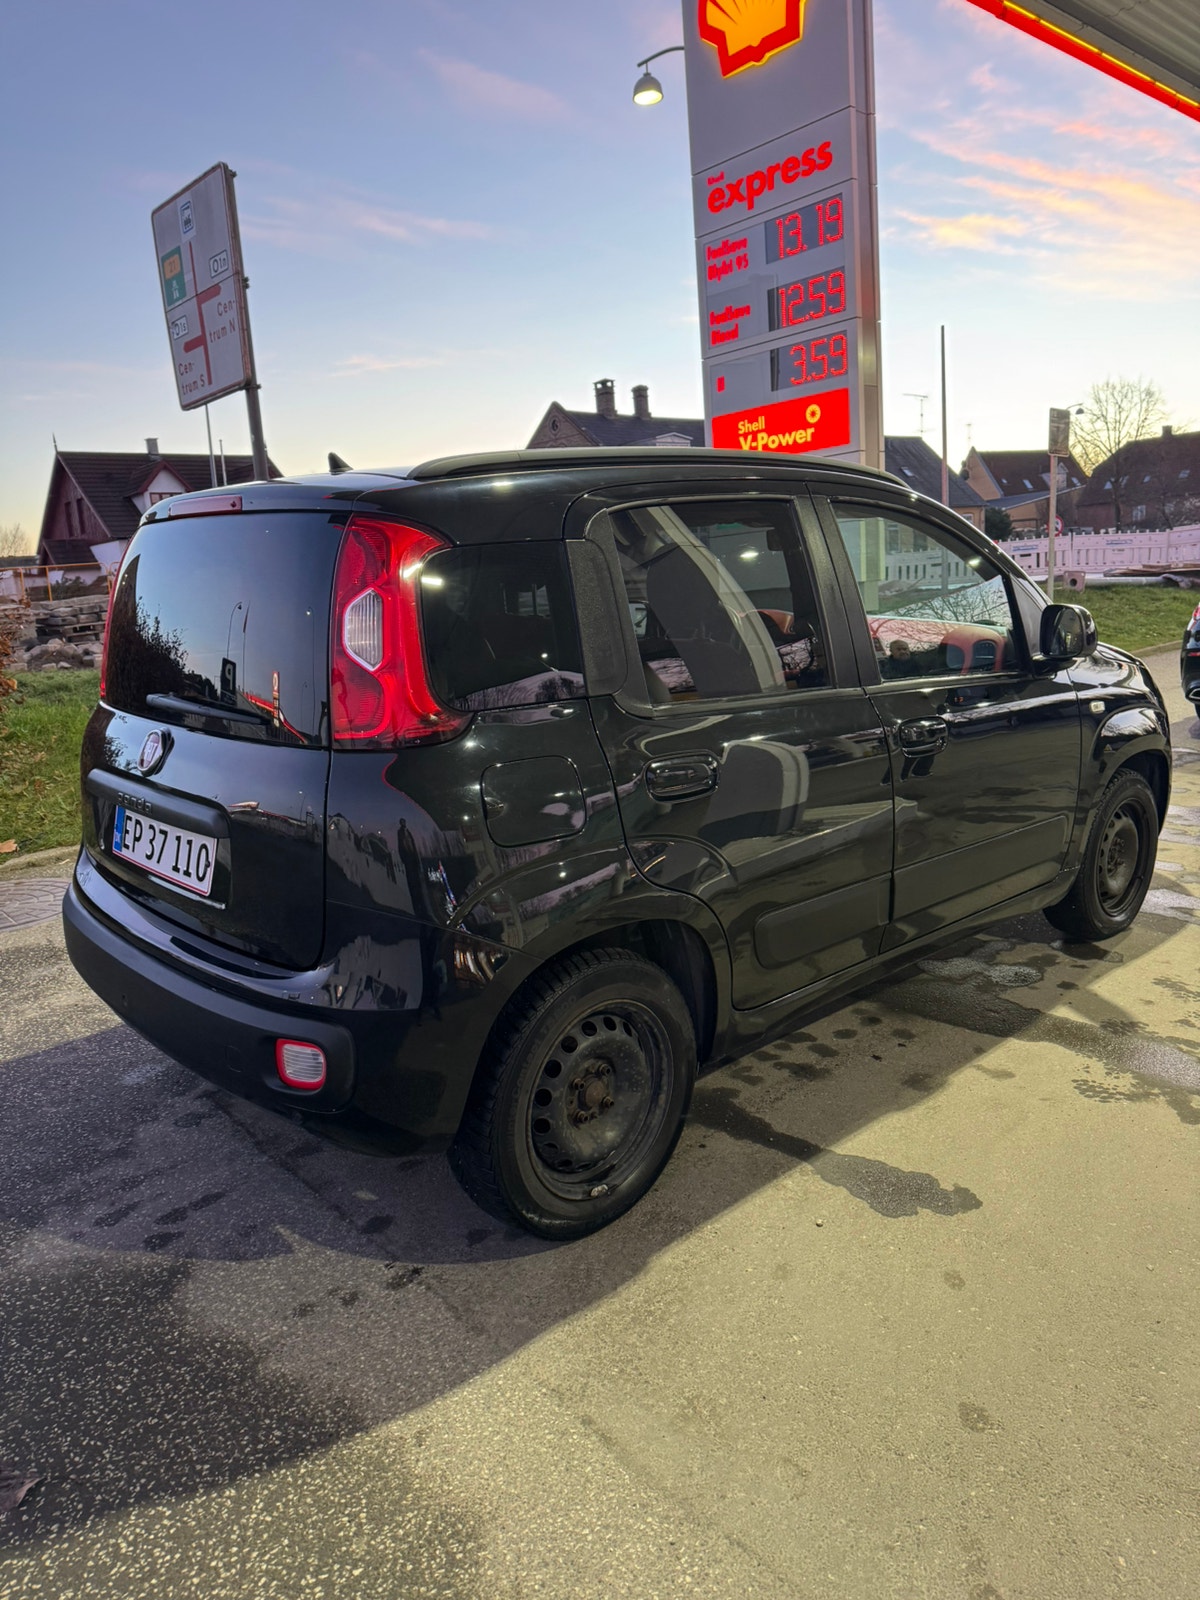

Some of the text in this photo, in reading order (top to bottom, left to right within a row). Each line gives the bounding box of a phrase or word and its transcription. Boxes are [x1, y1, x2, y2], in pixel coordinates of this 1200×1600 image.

[708, 141, 832, 213] express
[776, 198, 843, 259] 13.19
[779, 270, 845, 328] 12.59
[209, 318, 236, 343] trum N
[181, 373, 206, 395] trum S
[790, 334, 847, 385] 3.59
[738, 415, 765, 434] Shell
[739, 427, 815, 451] V-Power
[123, 814, 210, 882] EP 37 110
